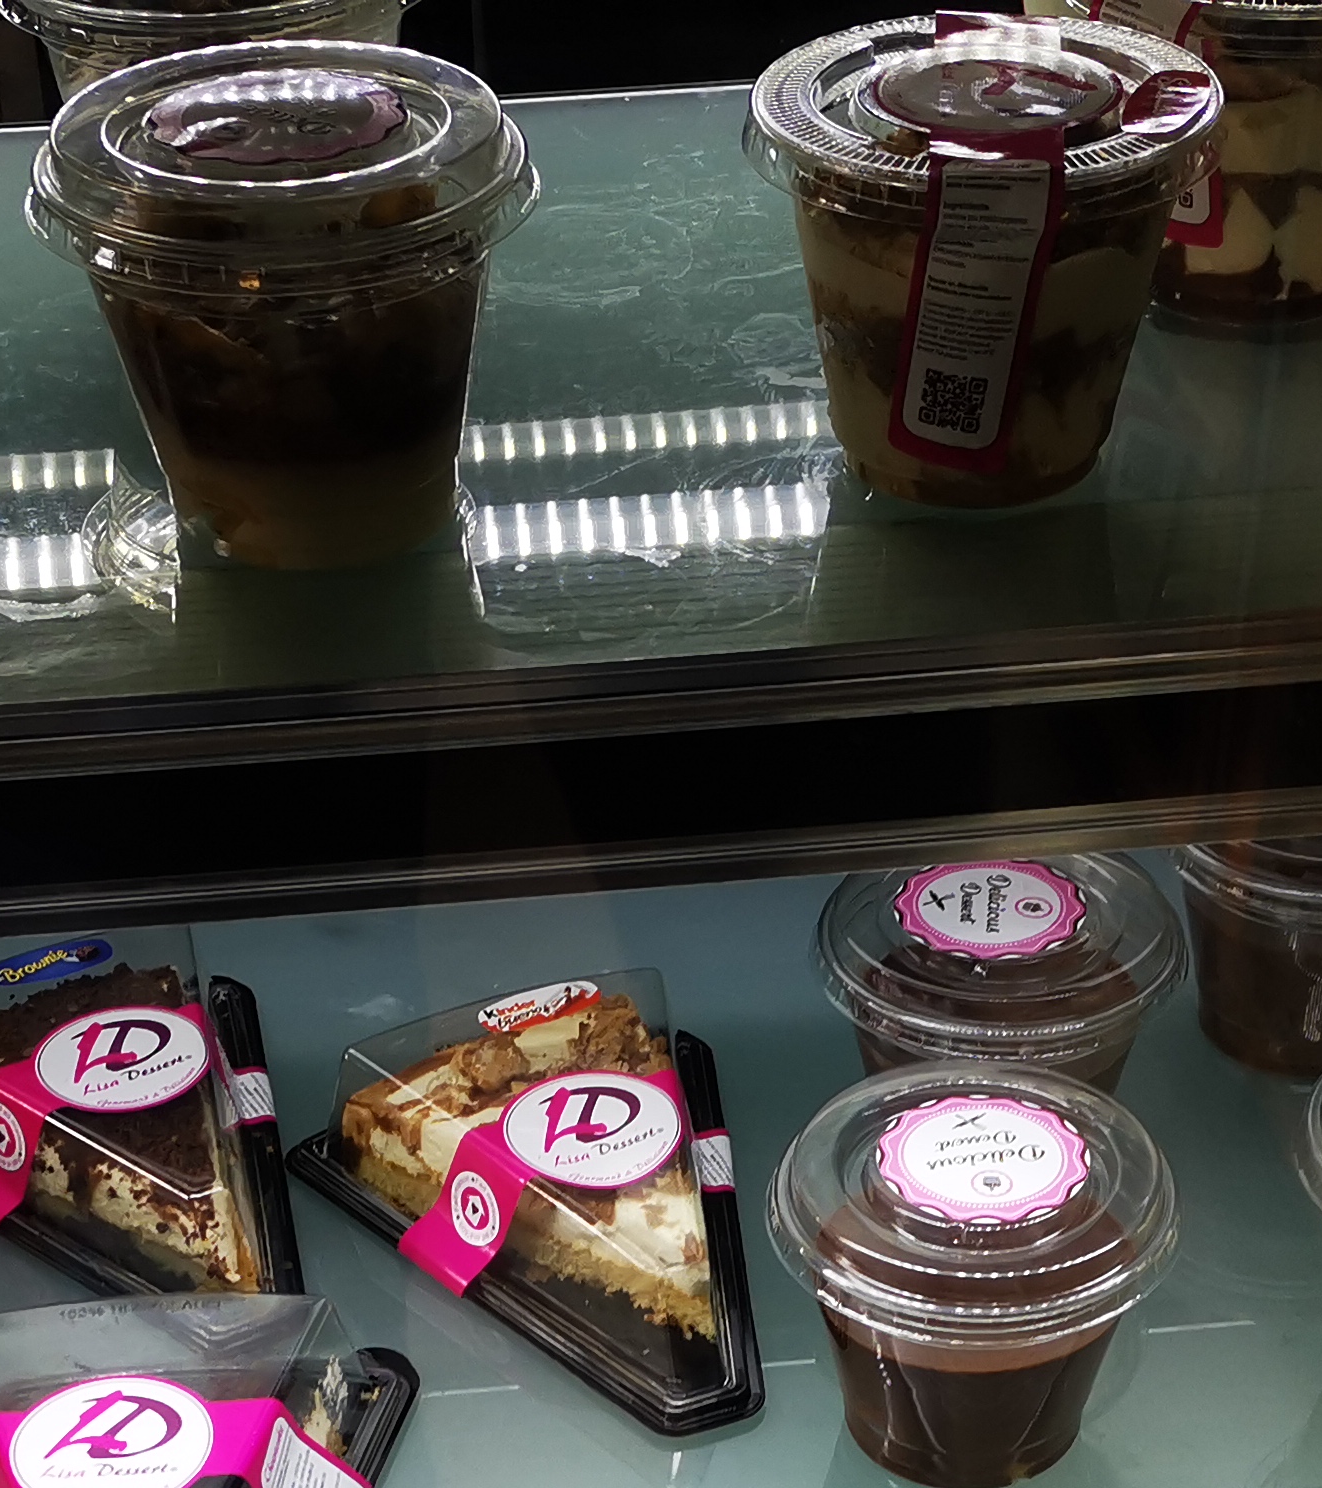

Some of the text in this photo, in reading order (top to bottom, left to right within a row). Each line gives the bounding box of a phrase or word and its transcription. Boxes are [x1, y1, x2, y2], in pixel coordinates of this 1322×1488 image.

[83, 1080, 119, 1096] Lisa
[554, 1127, 658, 1168] Lisa Dessert
[926, 1144, 1046, 1171] Delicious
[40, 1463, 169, 1479] Lisa Dessert
